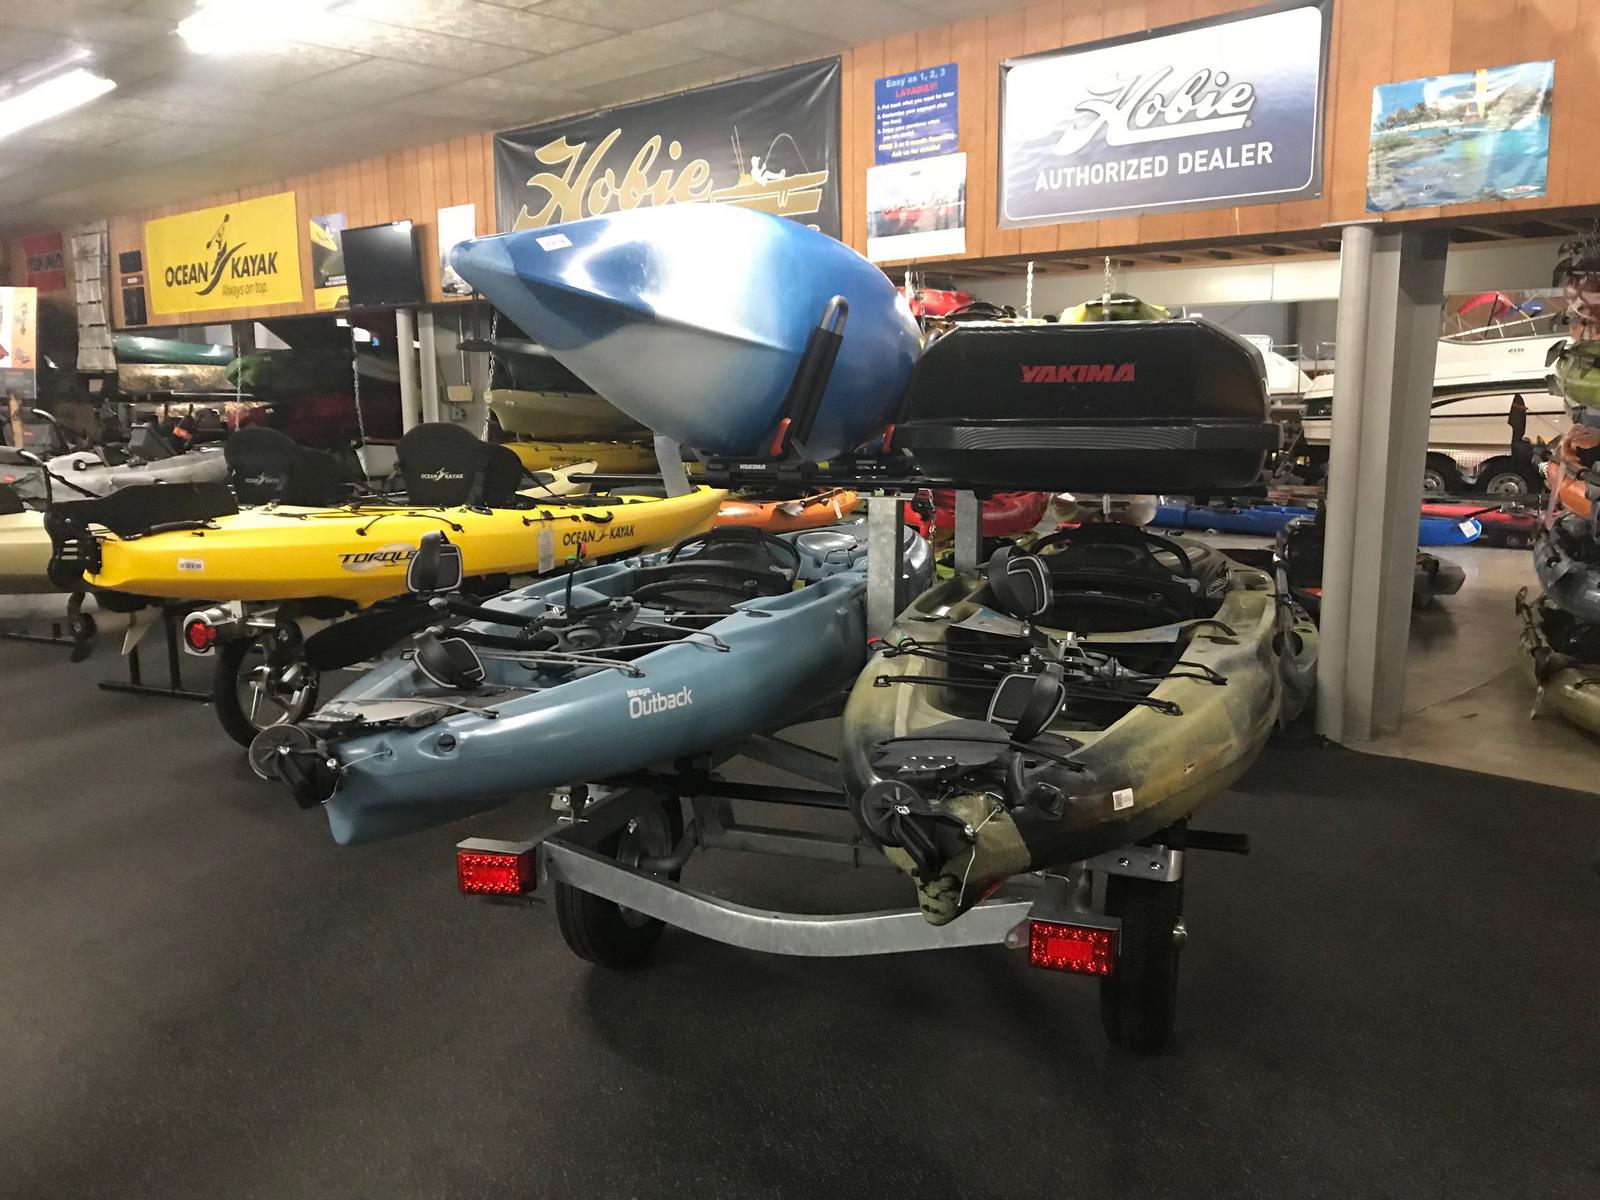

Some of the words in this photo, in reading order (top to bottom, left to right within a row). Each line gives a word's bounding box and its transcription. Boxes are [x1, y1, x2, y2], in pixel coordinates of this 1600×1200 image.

[886, 78, 905, 88] Easy
[907, 76, 918, 84] as
[920, 72, 928, 81] 1,
[929, 70, 938, 78] 2,
[940, 67, 946, 76] 3
[1053, 65, 1257, 156] Hobie
[511, 128, 714, 232] Hobie
[1034, 155, 1169, 192] AUTHORIZED
[1177, 141, 1274, 175] DEALER
[164, 261, 209, 288] OCEAN
[231, 251, 278, 279] KAYAK
[222, 283, 244, 298] Always
[244, 285, 254, 295] on
[1021, 363, 1136, 383] YAKIMA
[562, 531, 596, 546] OCEAN
[609, 524, 636, 540] KAYAK
[629, 685, 693, 719] Outback
